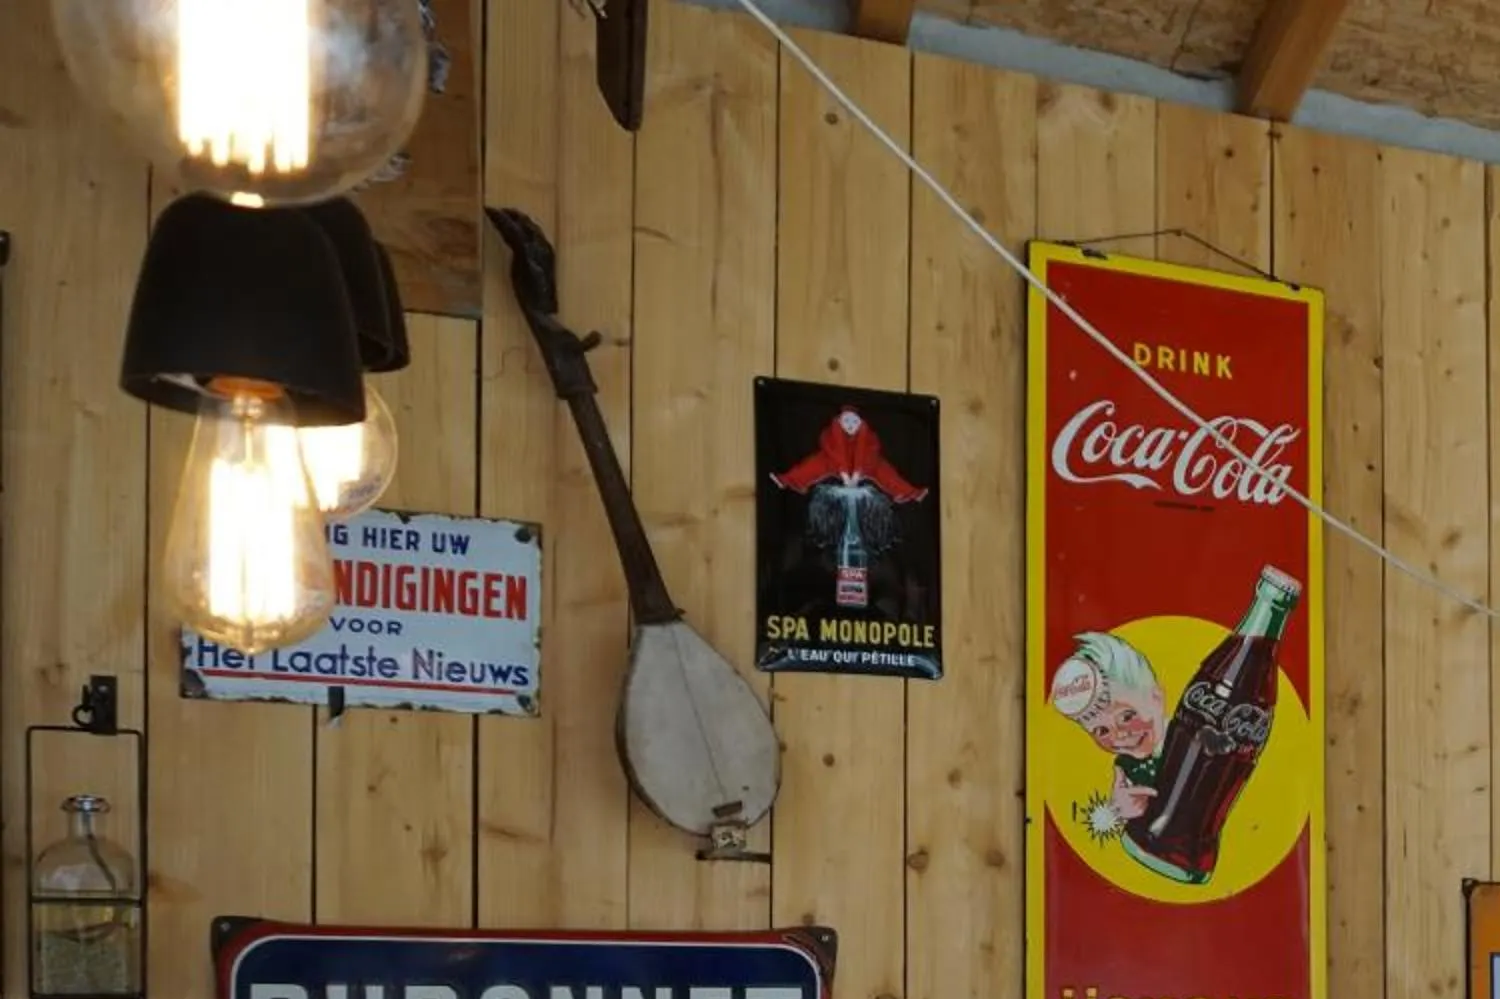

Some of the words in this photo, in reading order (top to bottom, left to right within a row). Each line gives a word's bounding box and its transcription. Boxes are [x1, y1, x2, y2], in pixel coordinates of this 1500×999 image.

[1133, 342, 1234, 380] DRINK
[361, 525, 421, 551] HIER
[431, 533, 471, 556] UW
[332, 558, 528, 621] NDIGINGEN
[328, 615, 404, 637] VOOR
[766, 614, 810, 641] SPA
[819, 618, 936, 648] MONOPOLE
[271, 643, 401, 680] Laatste
[411, 648, 530, 688] Nieuws
